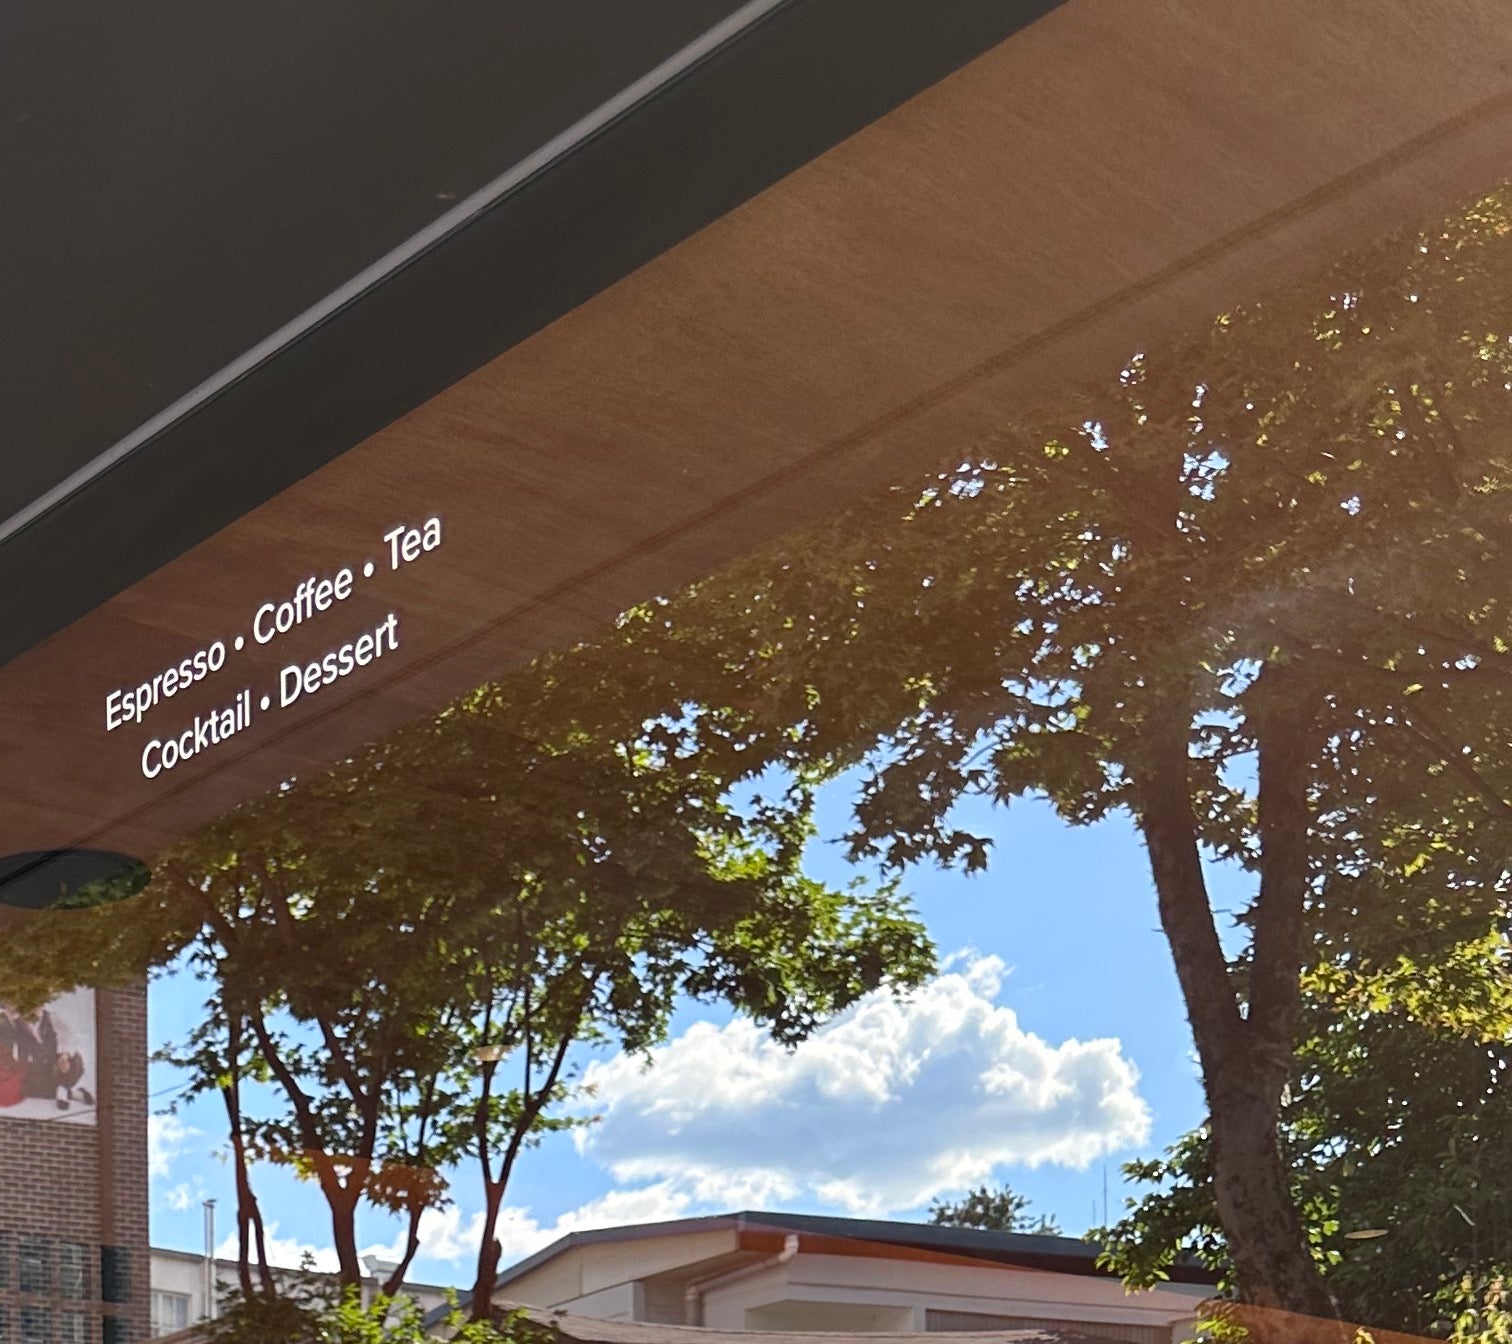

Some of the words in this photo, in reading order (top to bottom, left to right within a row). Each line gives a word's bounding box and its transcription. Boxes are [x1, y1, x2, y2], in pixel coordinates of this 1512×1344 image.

[106, 640, 226, 731] Espresso
[253, 568, 354, 644] Coffee
[383, 517, 441, 570] Tea
[141, 689, 251, 779] Cocktail
[280, 613, 399, 708] Dessert
